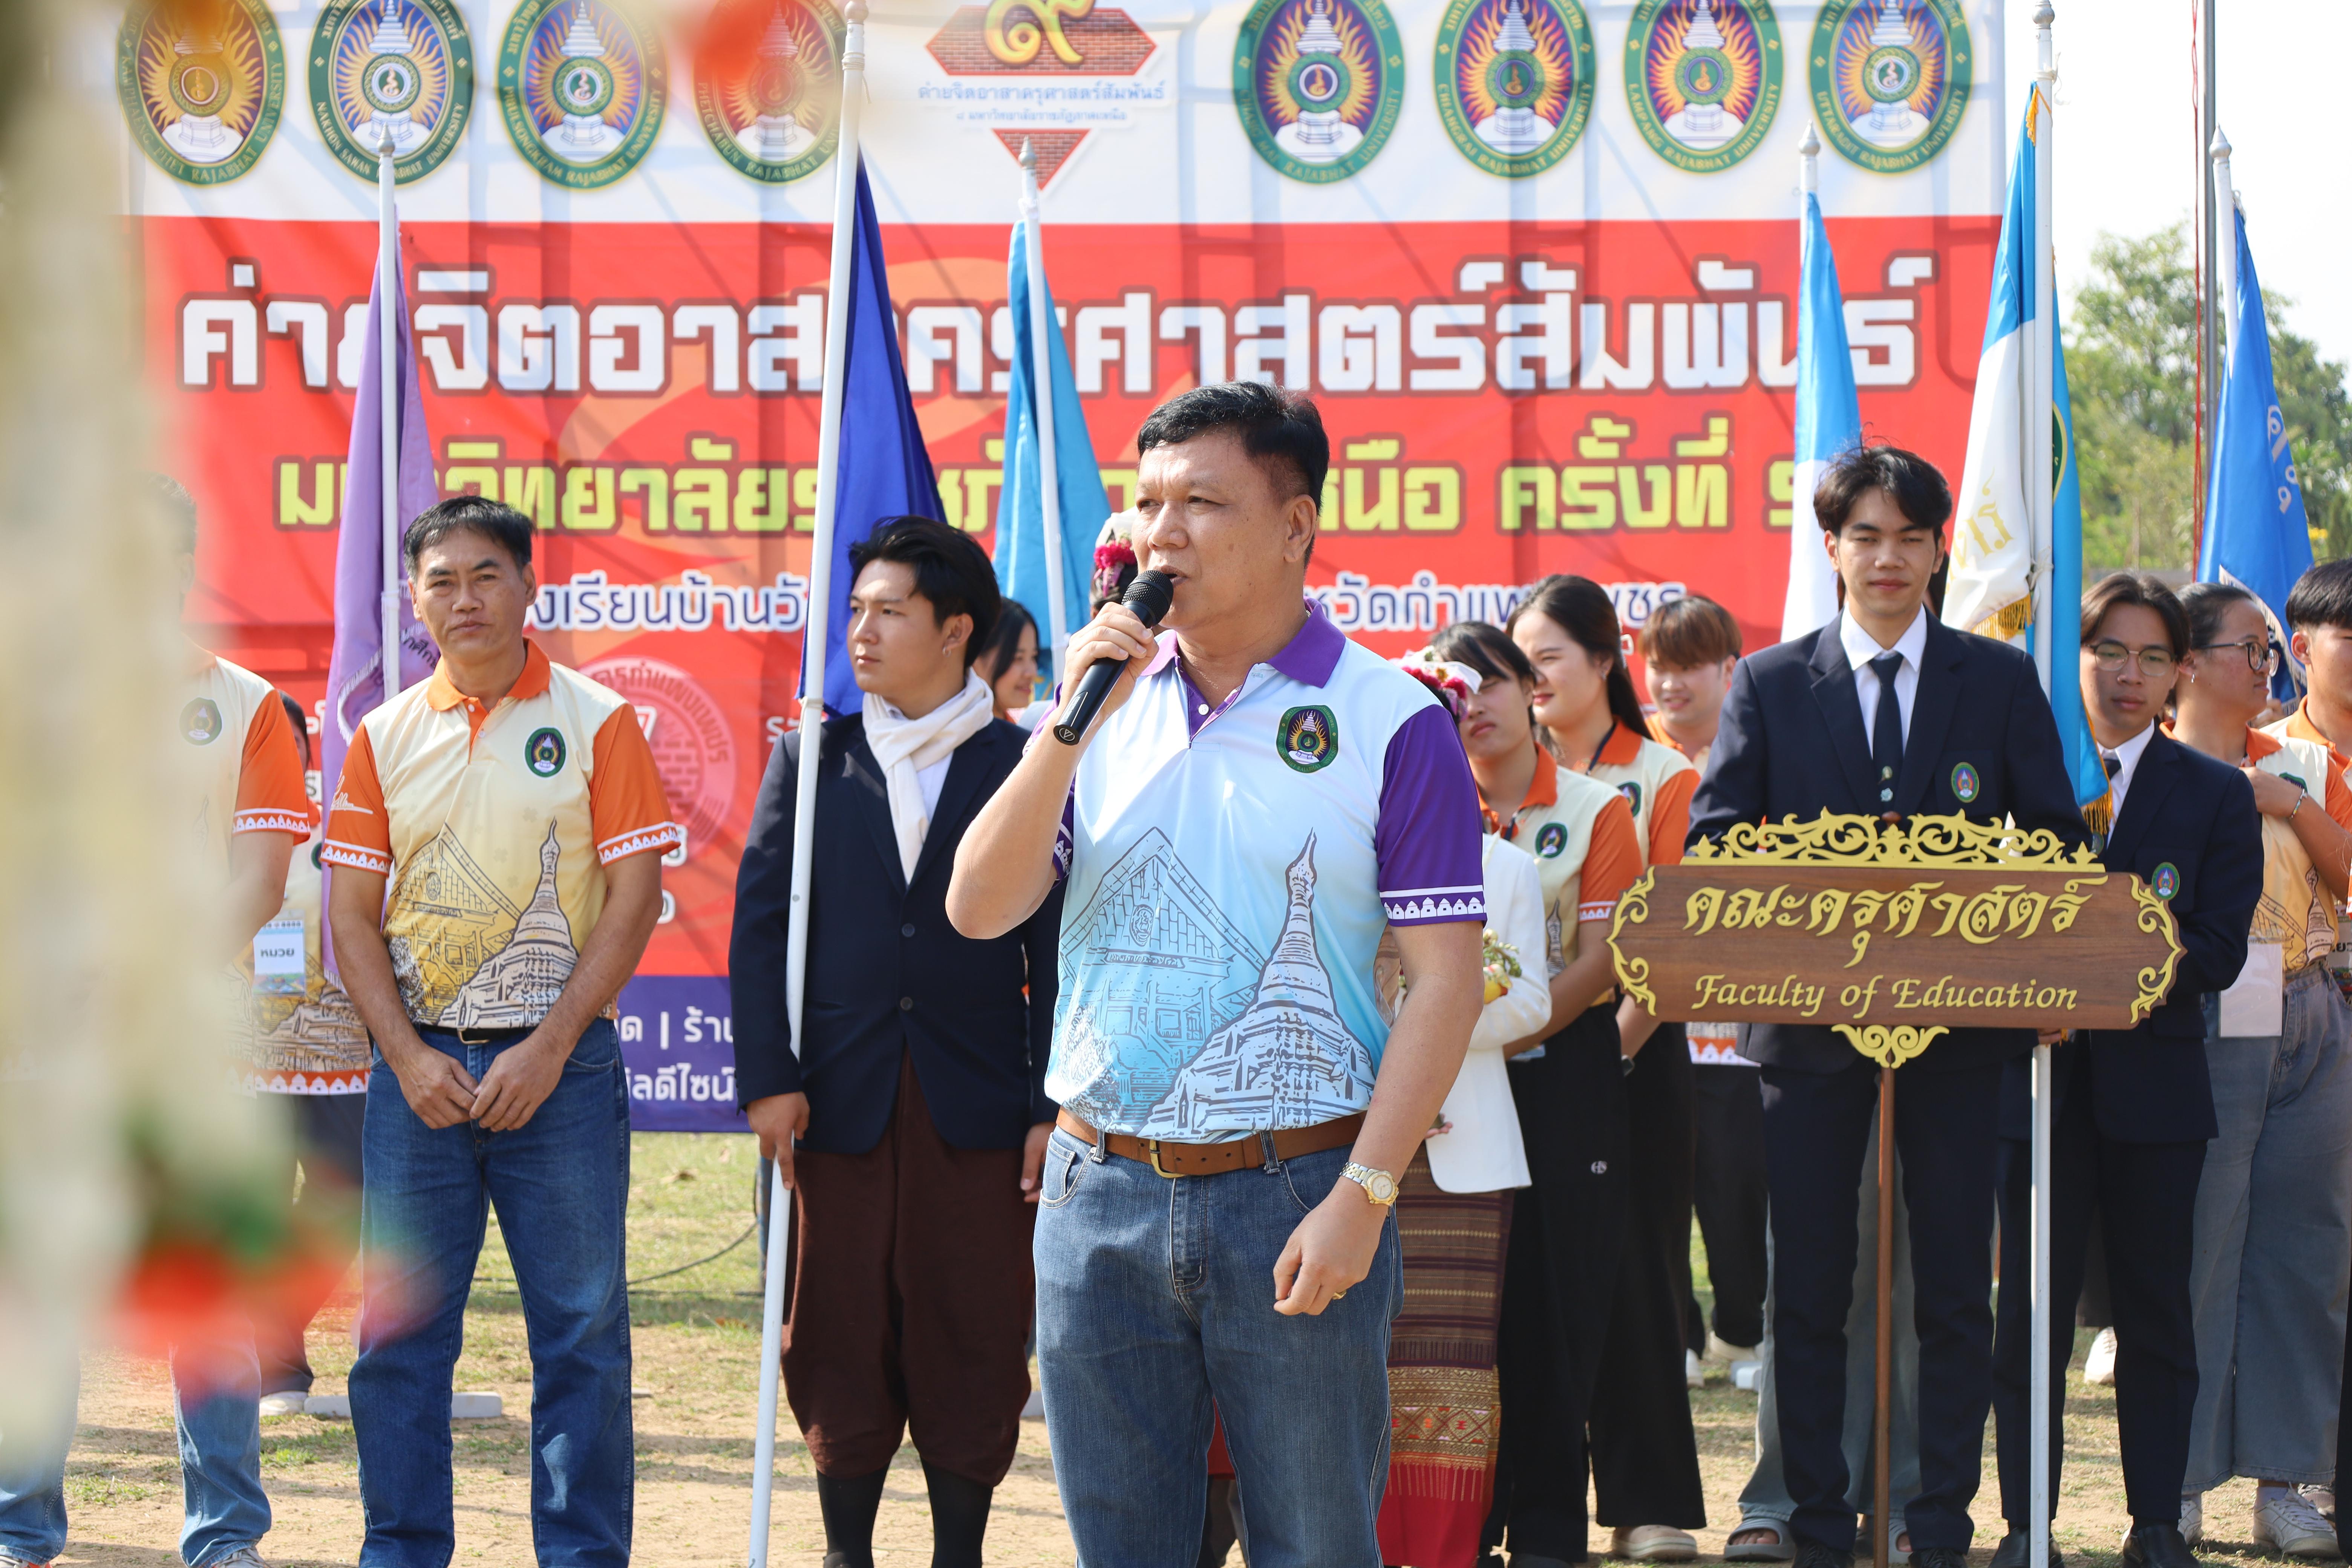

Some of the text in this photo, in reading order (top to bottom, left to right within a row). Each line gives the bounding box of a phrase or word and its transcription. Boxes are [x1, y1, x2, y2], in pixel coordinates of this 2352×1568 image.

[154, 147, 185, 176] PHET
[191, 146, 257, 183] RAJABHAT
[255, 61, 283, 142] UNIVERSITY
[317, 102, 342, 151] NAKHON
[340, 149, 372, 175] SAWAN
[426, 103, 464, 164] UNIVERSITY
[565, 156, 628, 187] RAJABHAT
[625, 89, 661, 159] UNIVERSITY
[698, 82, 818, 180] PHETCHABUN RAJABHAT
[918, 80, 1165, 106] ค่ายจิตอาสาครุศาสตร์สัมพันธ์
[1283, 161, 1355, 180] RAJABHAT
[1358, 87, 1401, 161] UNIVERSITY
[1478, 154, 1547, 174] RAJABHAT
[1549, 82, 1592, 159] UNIVERSITY
[1629, 82, 1779, 169] LAMPANG RAJABHAT UNIVERSITY
[1859, 150, 1920, 170] RAJABHAT
[1921, 89, 1964, 155] UNIVERSITY
[1501, 416, 1728, 530] ครั้งที่
[1682, 874, 2109, 969] คณะครุศาสตร์
[1692, 974, 2077, 1019] Faculty of Education
